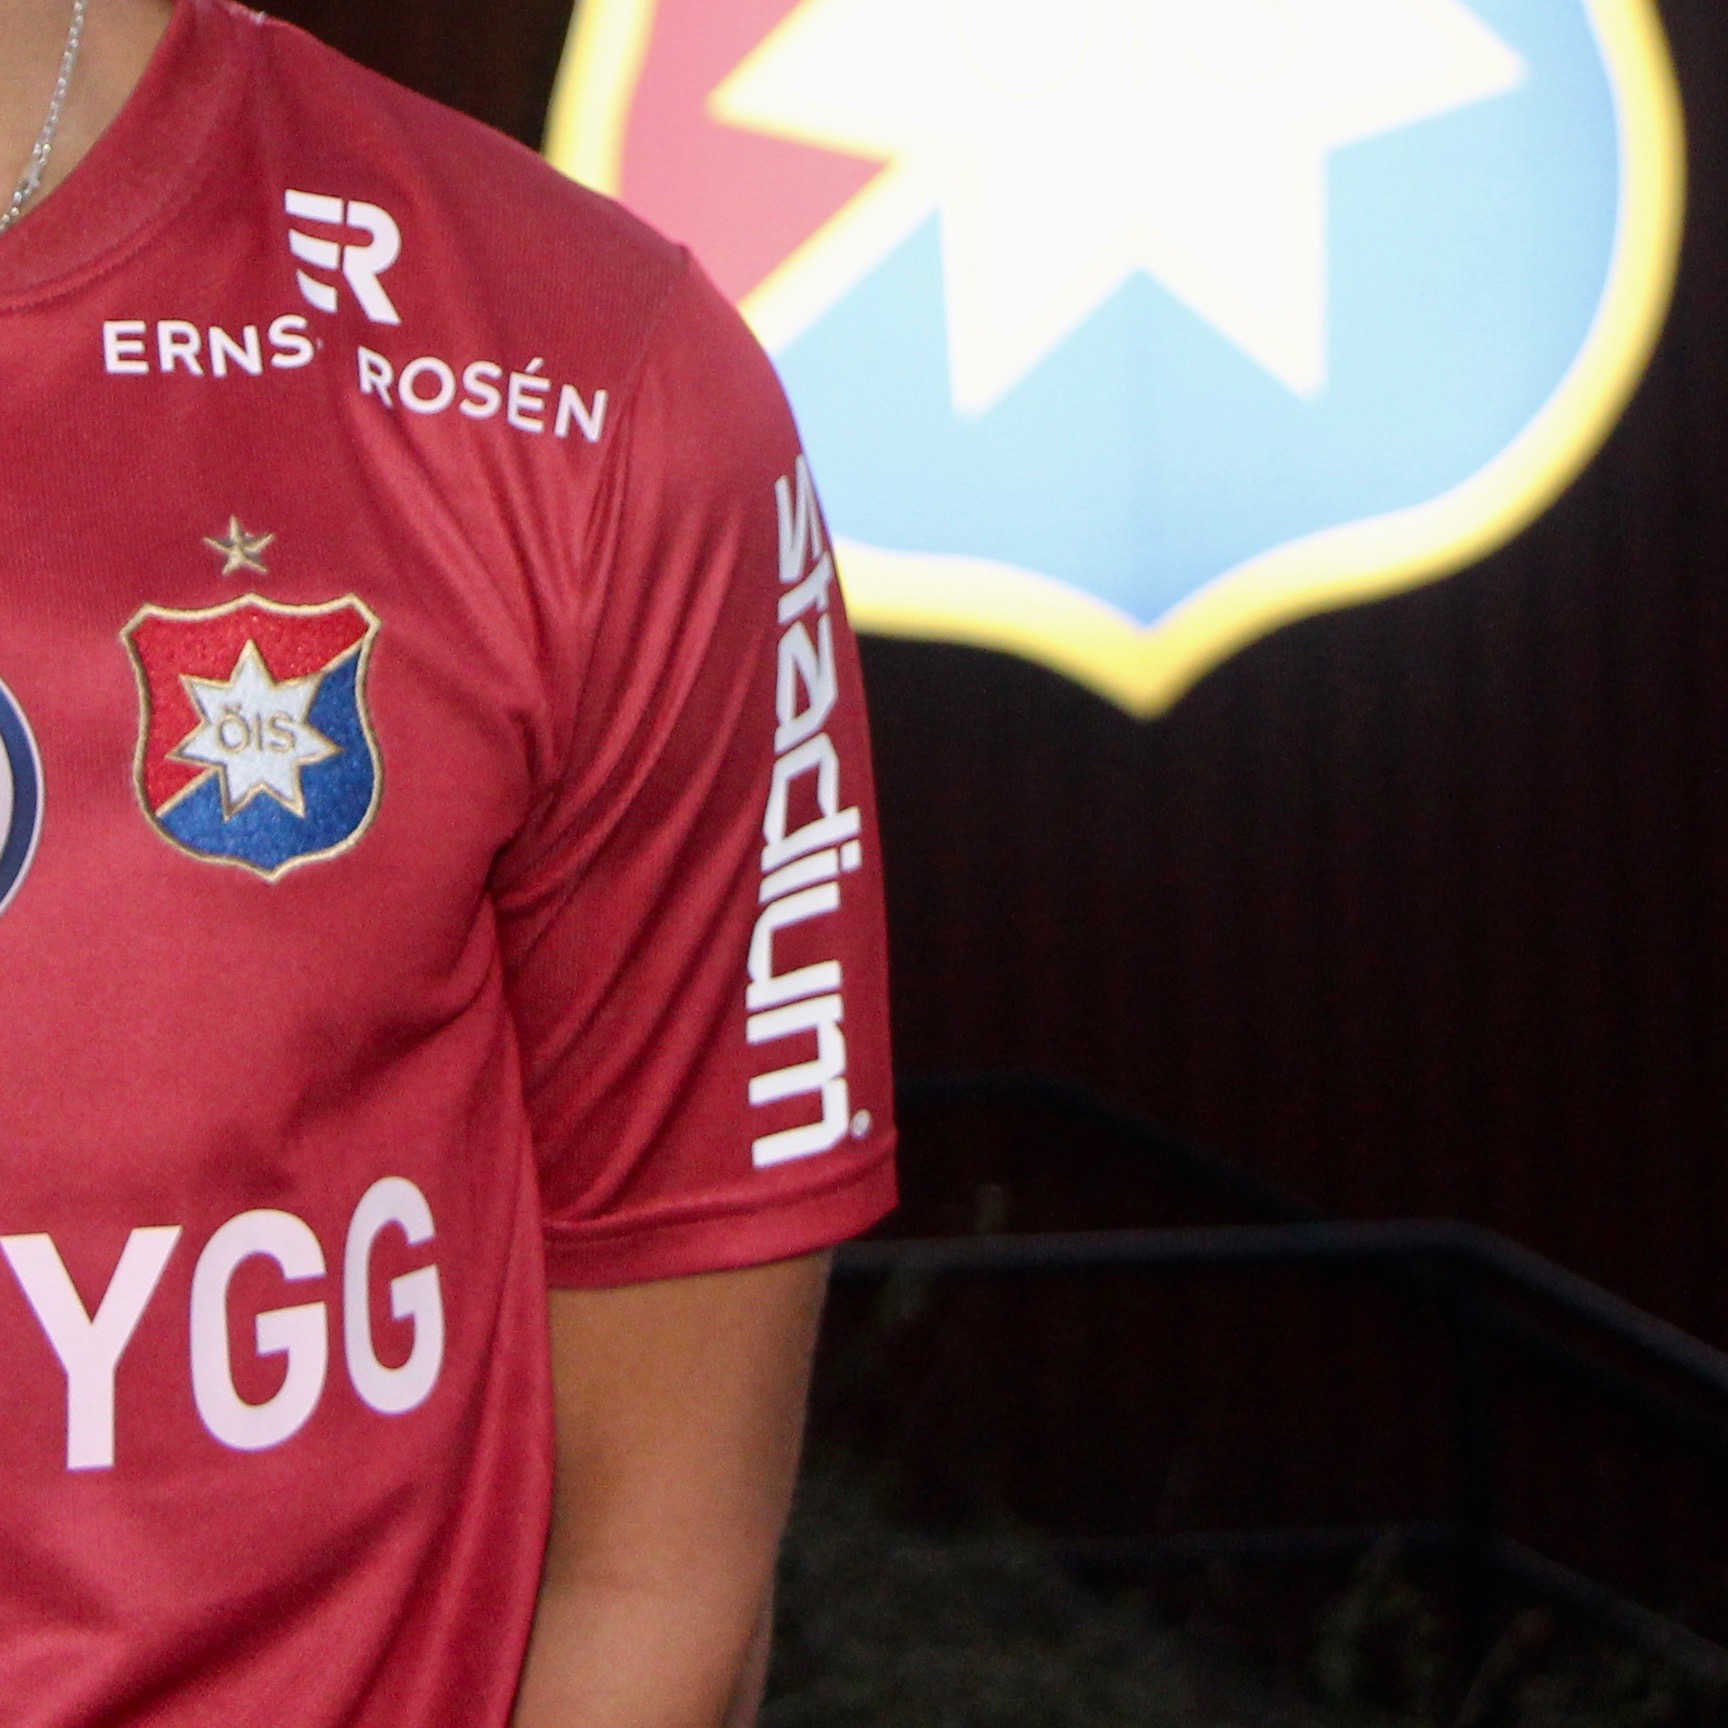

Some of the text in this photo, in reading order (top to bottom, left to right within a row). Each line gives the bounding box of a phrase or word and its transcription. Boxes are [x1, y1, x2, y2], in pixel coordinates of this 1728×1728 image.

[103, 315, 608, 443] ERNS ROSÉN
[216, 703, 297, 755] ÖIS
